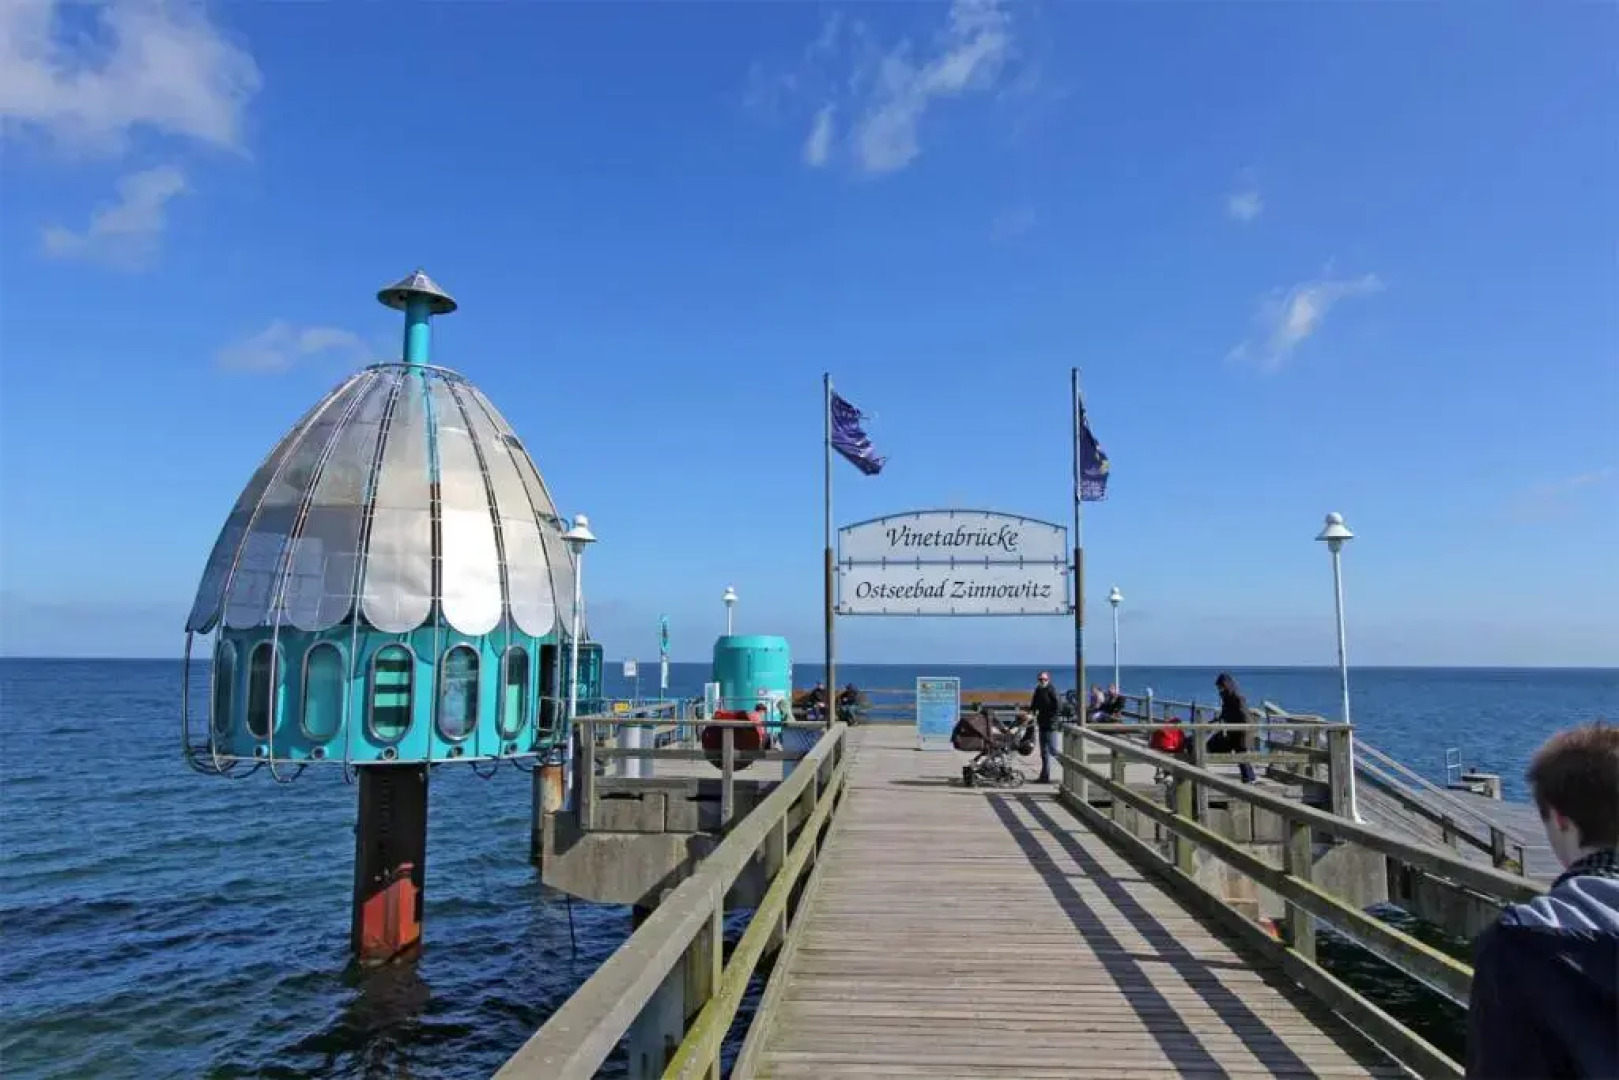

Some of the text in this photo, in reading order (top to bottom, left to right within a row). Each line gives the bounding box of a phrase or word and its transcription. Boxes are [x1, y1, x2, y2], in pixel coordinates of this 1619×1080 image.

[886, 525, 1019, 551] Vinetabrücke
[856, 578, 1051, 599] Ostseebad Zinnowitz
